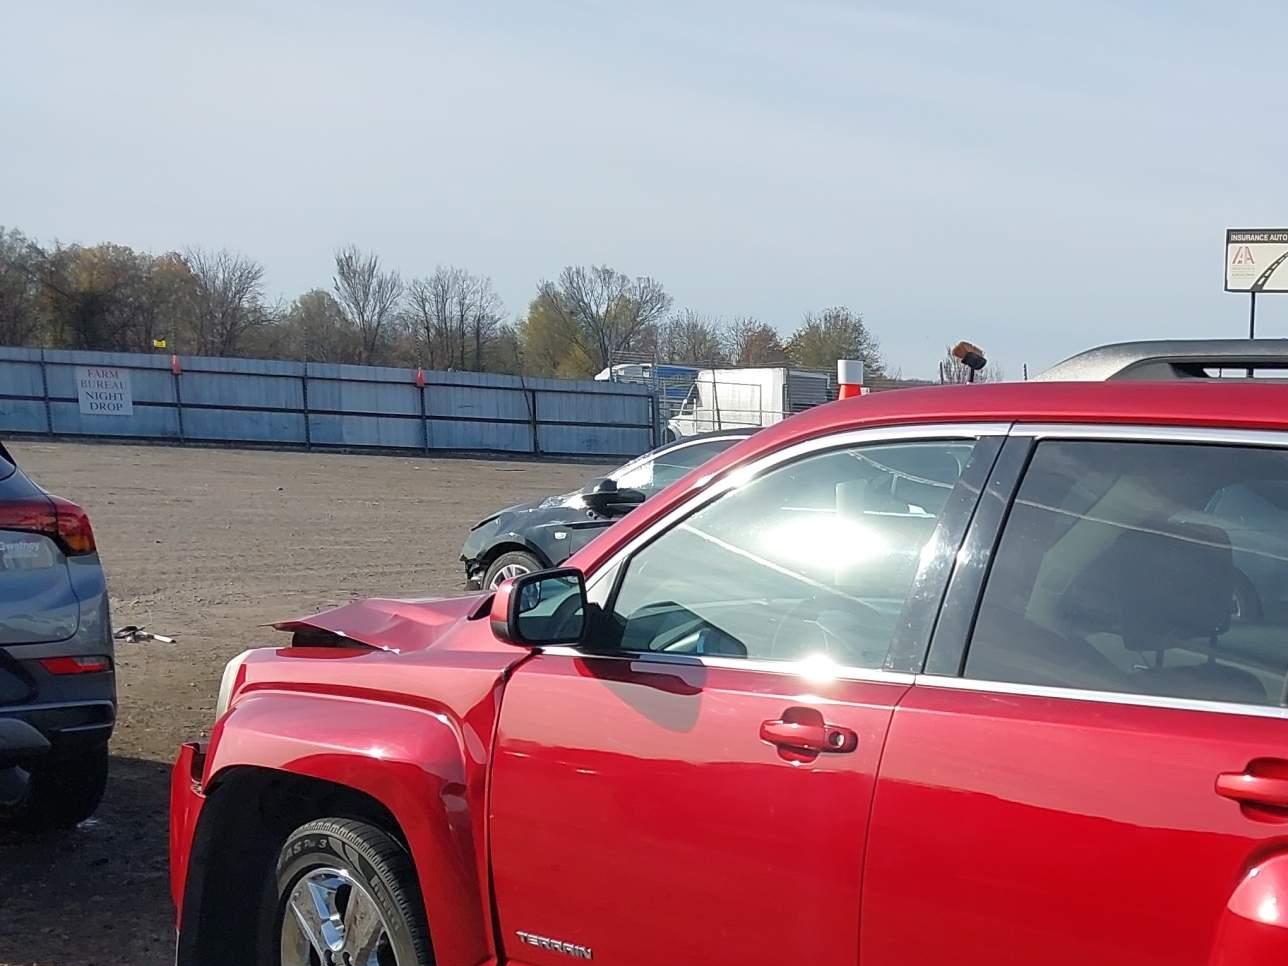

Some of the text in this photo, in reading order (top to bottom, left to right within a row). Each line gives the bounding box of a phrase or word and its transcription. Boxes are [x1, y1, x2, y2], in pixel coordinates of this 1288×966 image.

[1231, 233, 1269, 241] INSURANCE
[1269, 233, 1288, 241] AUTO
[87, 368, 119, 379] FARM
[80, 379, 128, 390] BUREAU
[86, 391, 123, 401] NIGHT
[90, 402, 123, 411] DROP
[515, 930, 593, 960] TERRAIN
